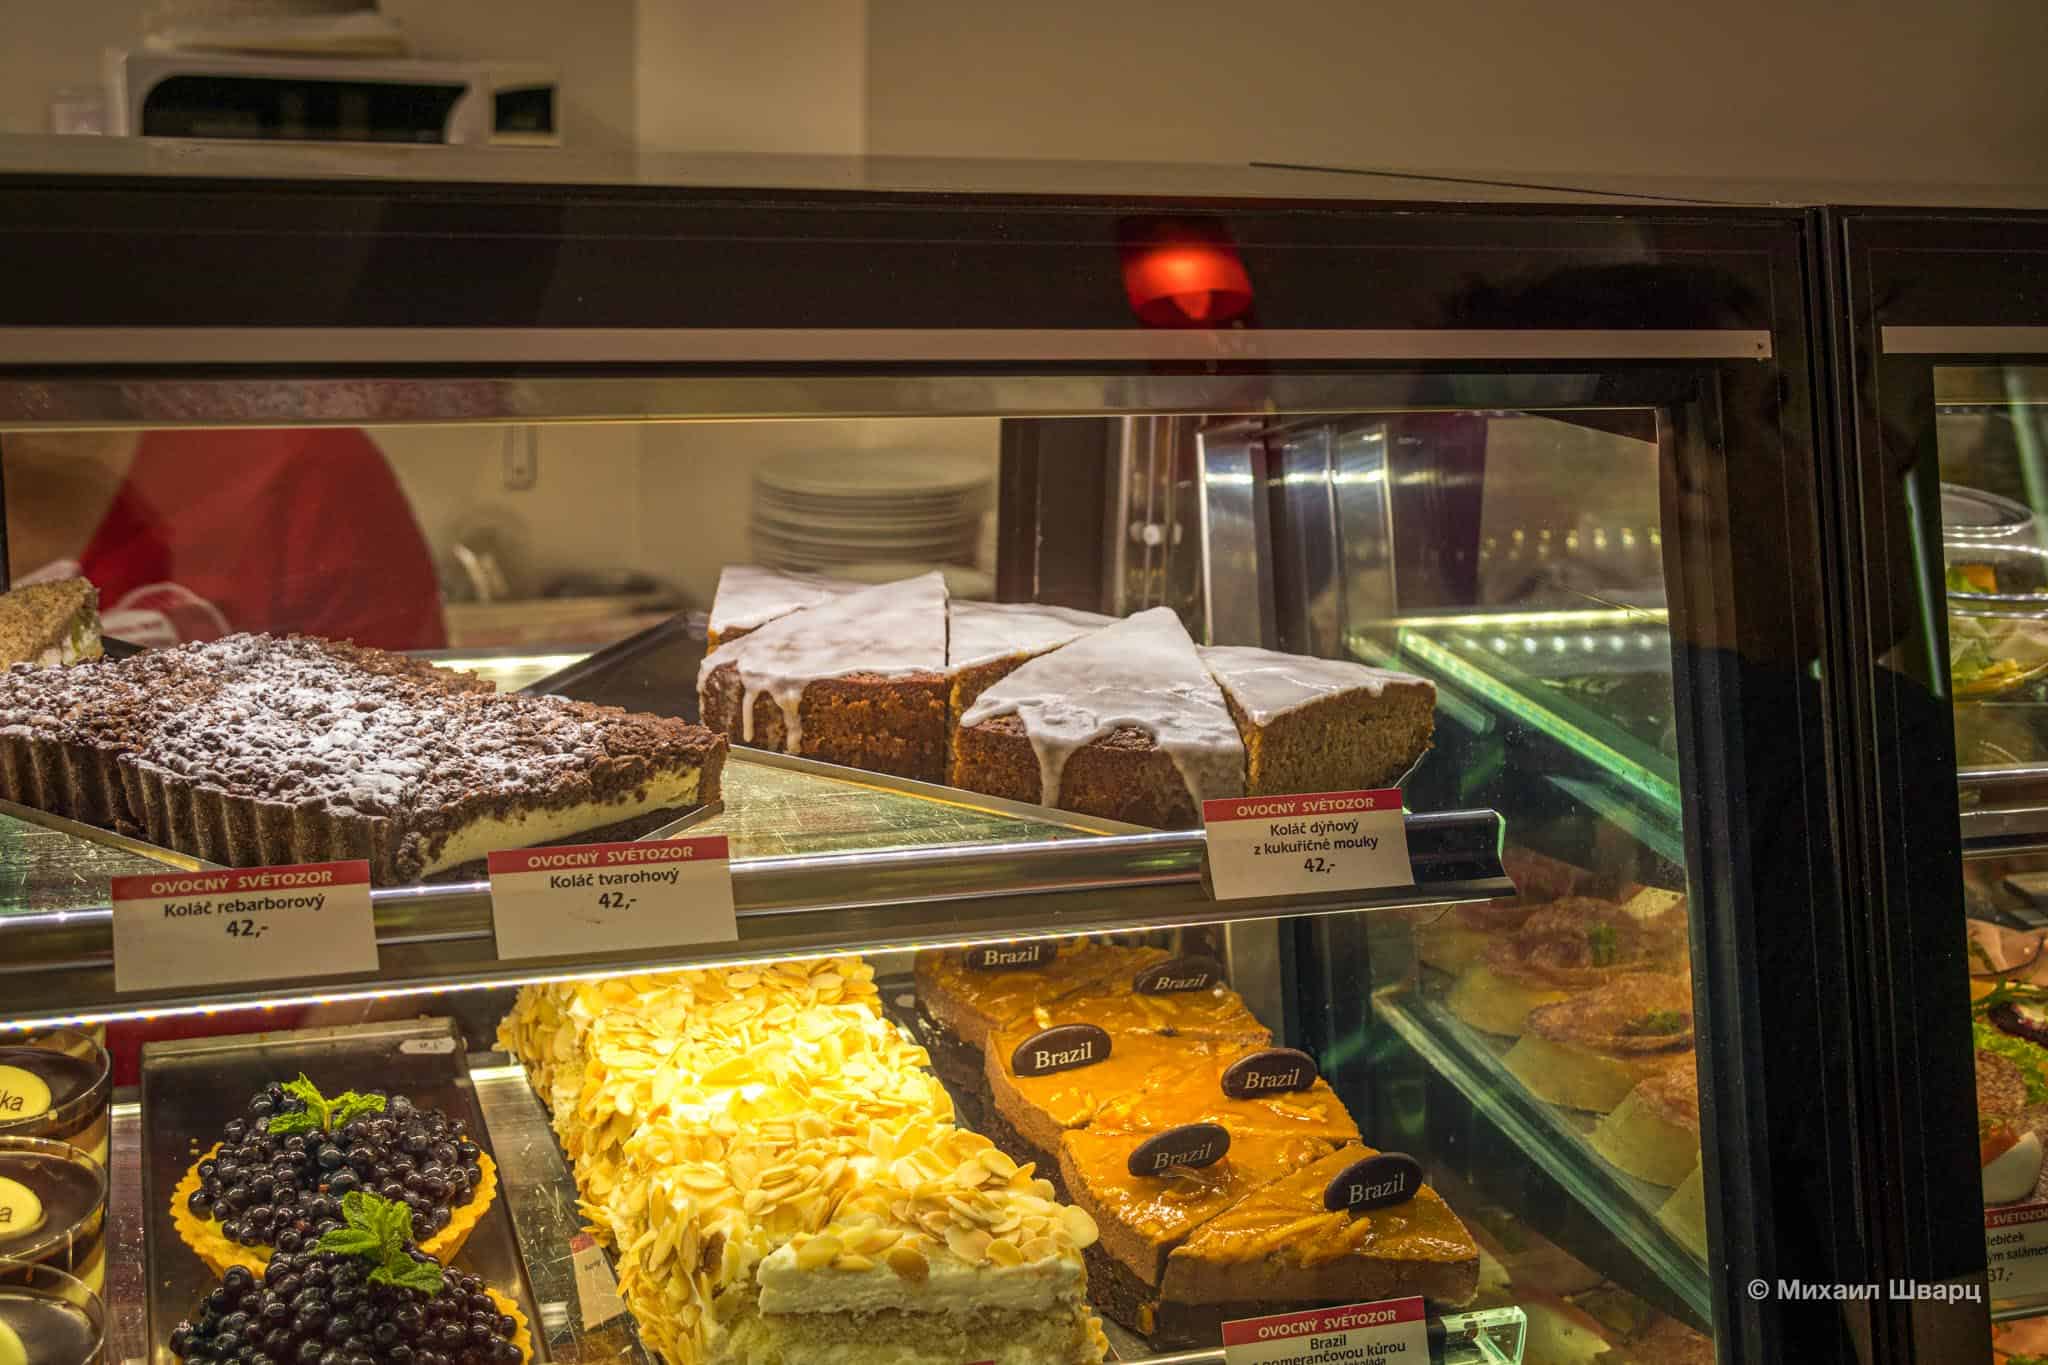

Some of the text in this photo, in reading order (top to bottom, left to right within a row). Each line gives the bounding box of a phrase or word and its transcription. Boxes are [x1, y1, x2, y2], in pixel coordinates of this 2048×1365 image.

[1236, 797, 1375, 816] OVOCNÝ SVĚTOZOR
[1270, 819, 1359, 837] Koláč dýňový
[1254, 836, 1378, 855] z kukuřičné mouky
[528, 845, 693, 868] OVOCNÝ SVĚTOZOR
[1304, 858, 1336, 874] 42,-
[152, 870, 332, 894] OVOCNÝ SVĚTOZOR
[550, 868, 679, 889] Koláč tvarohový
[164, 894, 326, 918] Koláč rebarborový
[598, 892, 636, 910] 42,-
[226, 920, 268, 938] 42,-
[983, 946, 1040, 966] Brazil
[1154, 973, 1208, 990] Brazil
[1035, 1042, 1092, 1070] Brazil
[1244, 1068, 1300, 1088] Brazil
[1153, 1144, 1213, 1168] Brazil
[1349, 1173, 1404, 1204] Brazil
[1258, 1310, 1396, 1338] OVOCNÝ SVĚTOZOR
[1310, 1334, 1346, 1350] Brazil
[1367, 1342, 1406, 1357] kůrou
